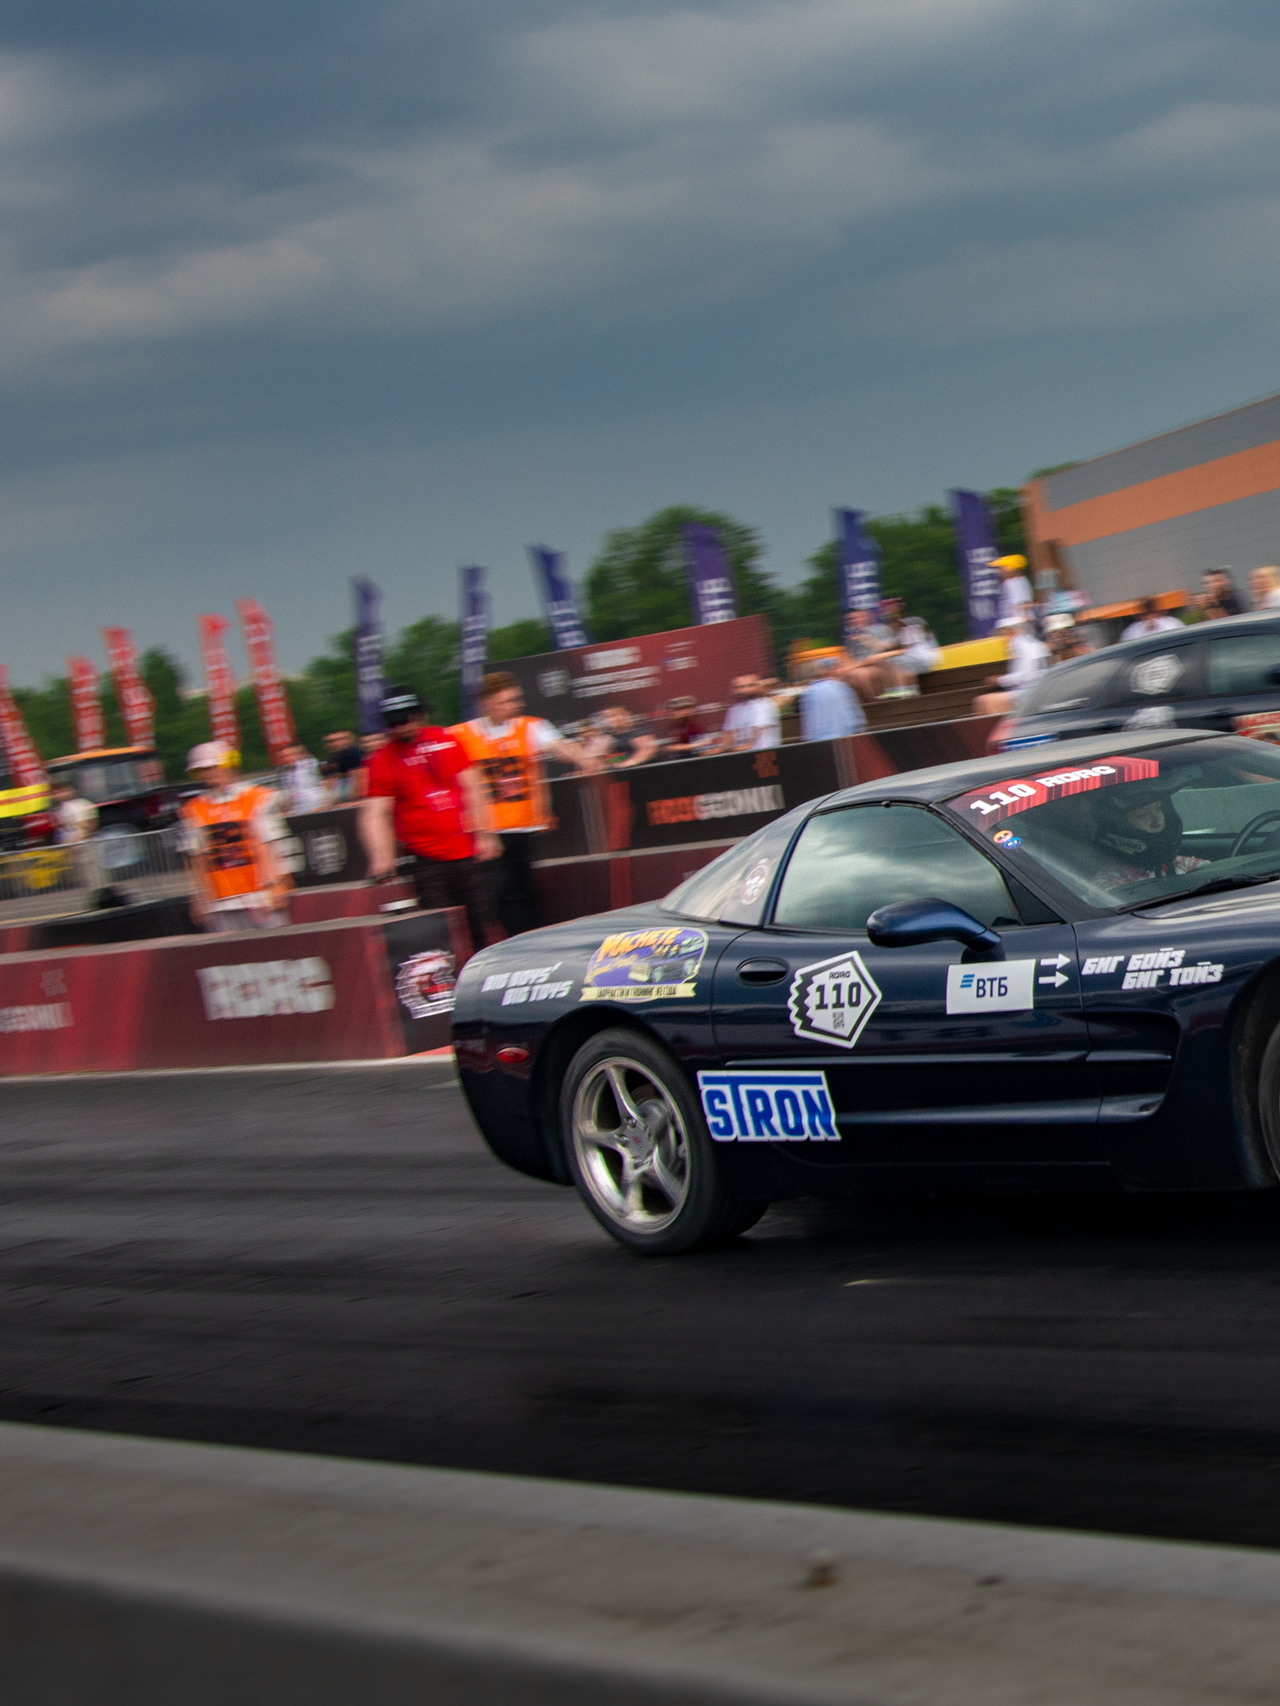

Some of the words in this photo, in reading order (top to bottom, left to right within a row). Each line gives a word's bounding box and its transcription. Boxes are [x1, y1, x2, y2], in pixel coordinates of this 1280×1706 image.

[970, 784, 1036, 815] 110
[1035, 766, 1116, 788] RDRC
[597, 927, 683, 963] MACHETE
[1082, 955, 1125, 975] БИГ
[1127, 947, 1186, 971] БОЙЗ
[1122, 970, 1164, 990] БИГ
[1169, 961, 1225, 986] ТОЙЗ
[481, 972, 512, 992] BIG
[501, 985, 531, 1006] BIG
[528, 980, 575, 1002] TOYS
[815, 981, 861, 1010] 110
[976, 976, 1008, 998] ВТБ
[700, 1074, 837, 1137] STRON
